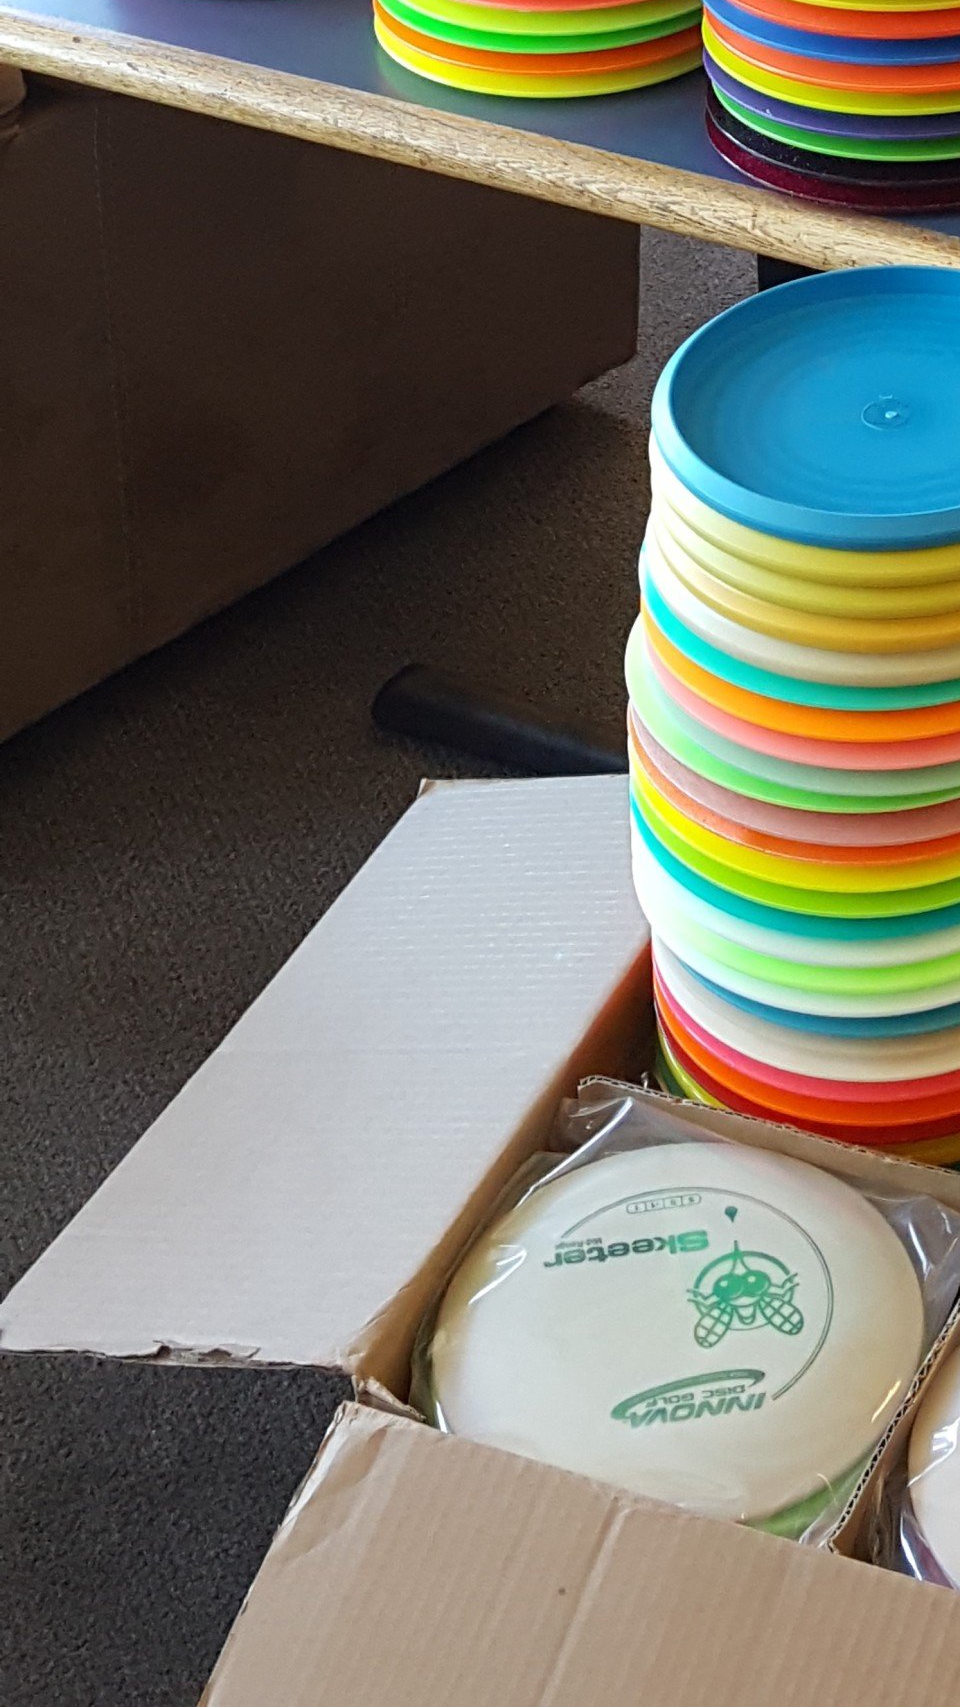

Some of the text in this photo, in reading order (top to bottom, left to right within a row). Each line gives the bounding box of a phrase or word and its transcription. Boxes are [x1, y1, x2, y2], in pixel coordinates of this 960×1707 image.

[543, 1229, 710, 1268] Skeeter
[630, 1392, 767, 1428] INNOVA
[646, 1384, 746, 1408] DISC GOLF
